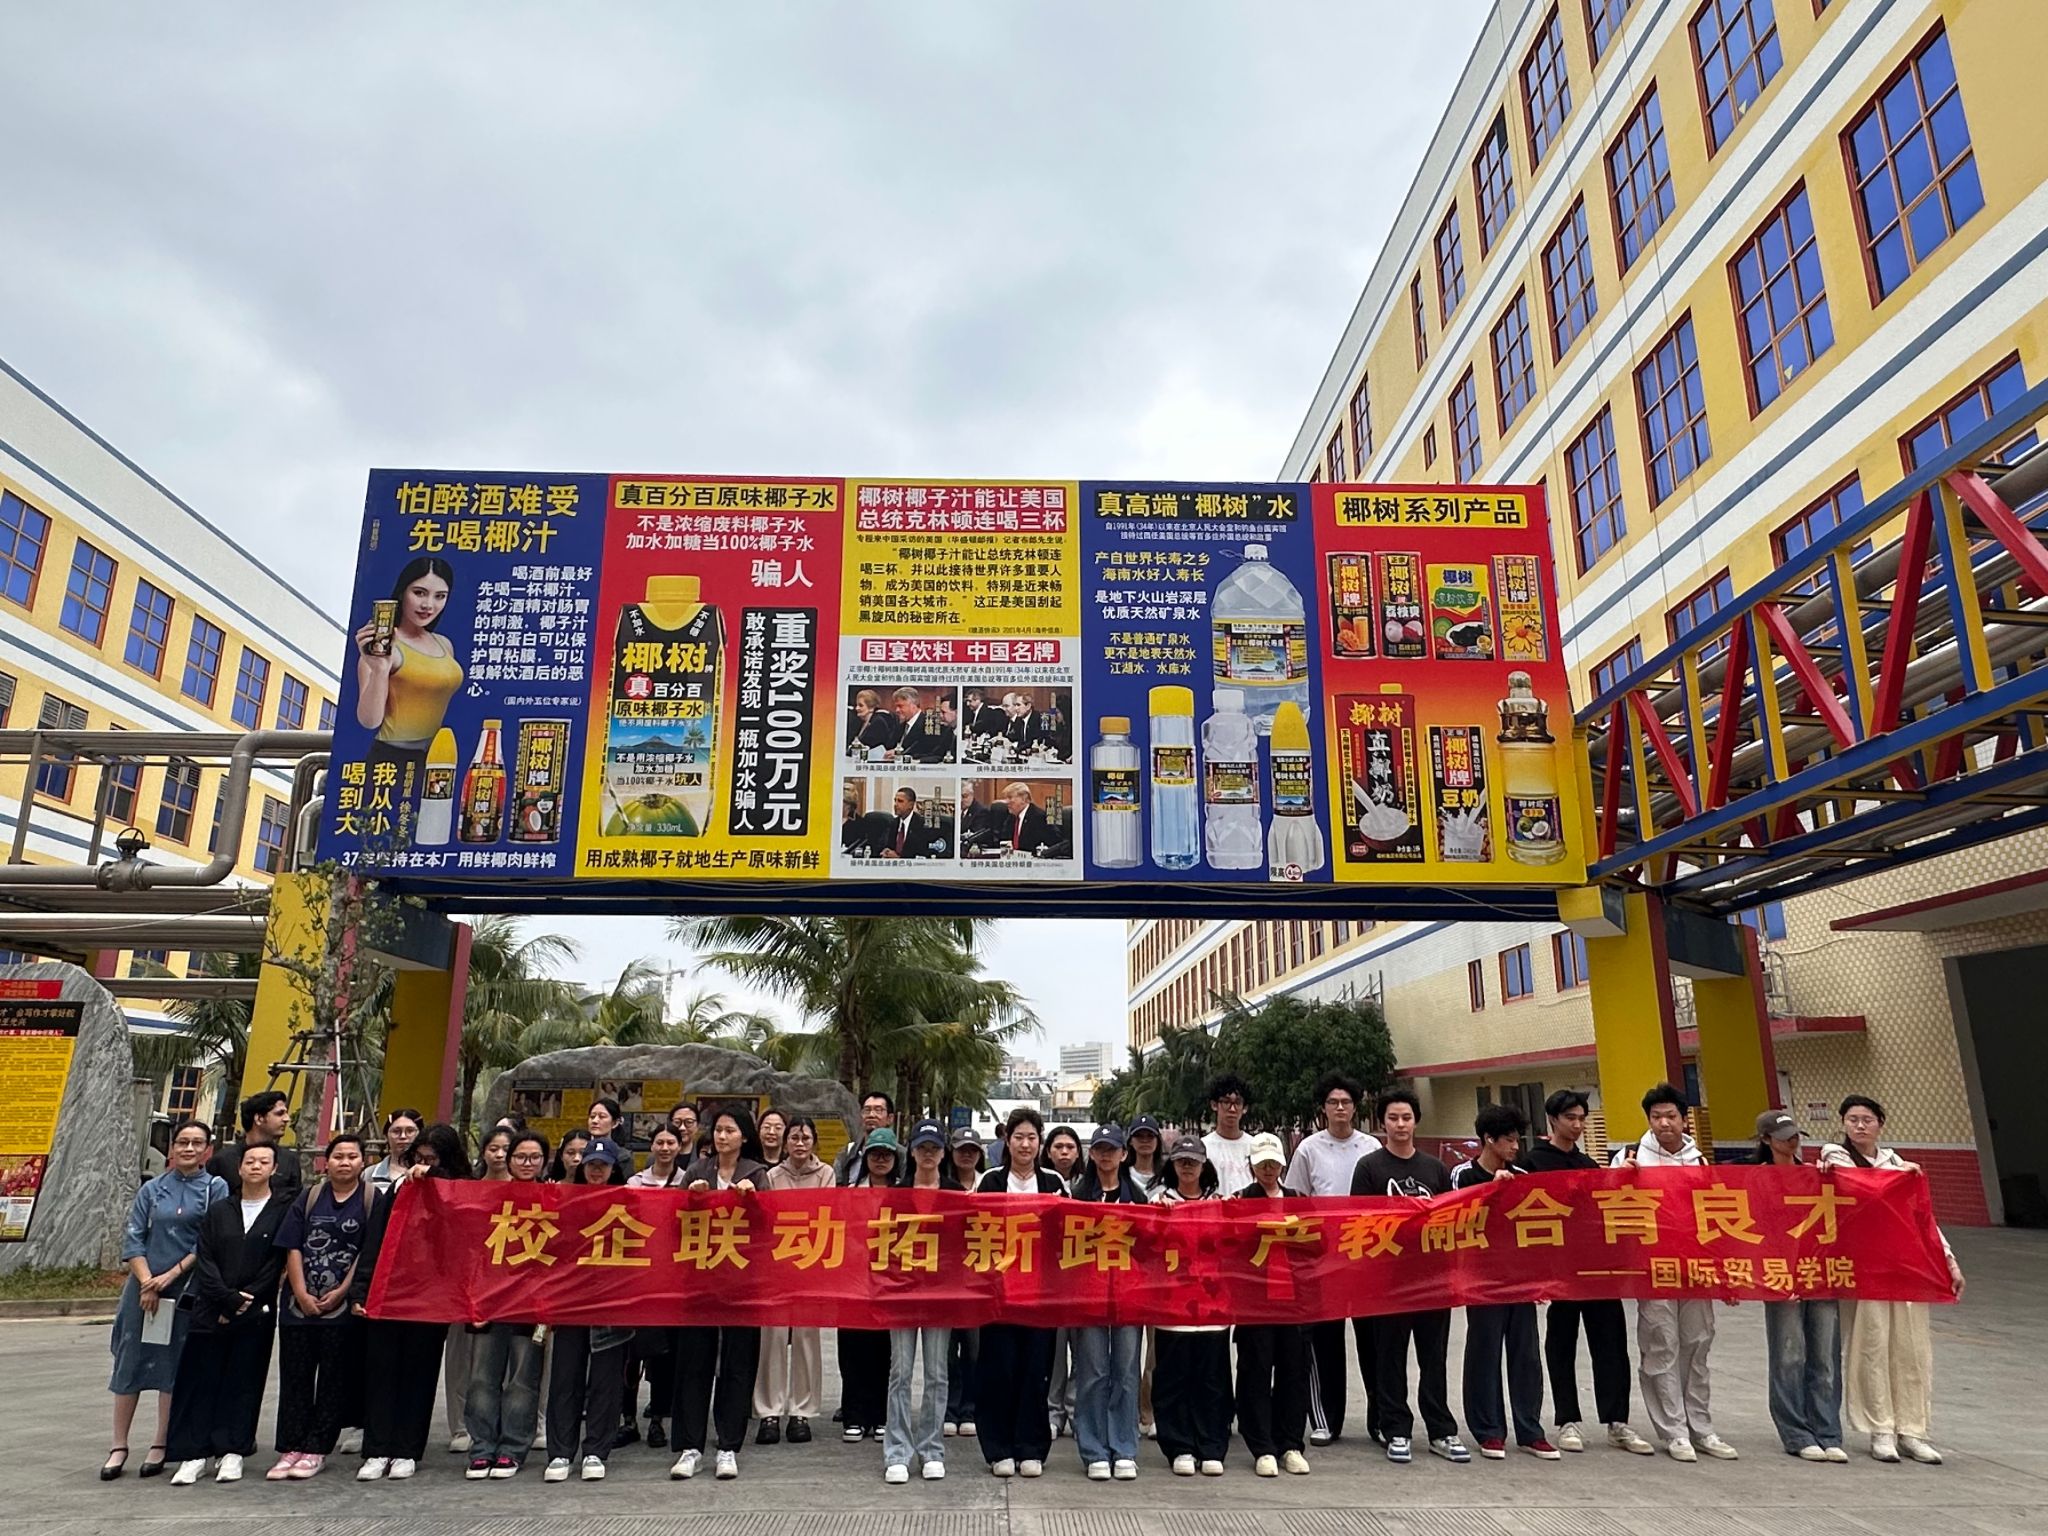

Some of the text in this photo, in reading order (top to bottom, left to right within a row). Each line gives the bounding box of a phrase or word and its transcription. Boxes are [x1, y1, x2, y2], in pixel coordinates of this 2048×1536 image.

[396, 481, 579, 516] 怕醉酒难受
[620, 484, 834, 508] 真百分百原味椰子水
[858, 487, 1064, 509] 椰树椰子汁能让美国
[858, 510, 1065, 531] 总统克林顿连喝三杯
[1343, 497, 1520, 525] 椰树系列产品
[637, 515, 805, 533] 不是浓缩废料椰子水
[408, 520, 557, 554] 先喝椰汁
[626, 533, 814, 551] 加水加糖当100%椰子水
[1094, 551, 1210, 565] 产自世界长寿之乡
[512, 566, 593, 581] 喝酒前最好
[751, 559, 814, 588] 骗人
[1102, 568, 1204, 582] 海南水好人寿长
[1443, 570, 1472, 583] 椰树
[1507, 565, 1527, 602] 椰树牌
[1341, 566, 1360, 606] 椰树牌
[476, 598, 590, 614] 减少酒精对肠胃
[1095, 591, 1207, 604] 是地下火山岩深层
[1102, 606, 1200, 620] 优质天然矿泉水
[473, 632, 587, 647] 中的蛋白可以保
[1109, 633, 1190, 645] 不是普通矿泉水
[621, 641, 708, 674] 椰树
[866, 641, 1055, 662] 国宴饮料 中国名牌
[1104, 648, 1196, 660] 更不是地表天然水
[469, 665, 583, 682] 缓解饮酒后的恶
[627, 677, 703, 698] 真 百分百
[615, 702, 703, 718] 原味椰子水
[1350, 700, 1404, 728] 椰树
[734, 612, 766, 830] 敢承诺发现一瓶加水骗人
[762, 612, 811, 831] 重奖100万元
[527, 737, 552, 786] 椰树牌
[616, 753, 695, 764] 不是用浓缩椰子水
[635, 764, 674, 774] 加水加糖
[1367, 730, 1394, 803] 真椰奶
[1446, 737, 1470, 785] 椰树牌
[675, 774, 702, 785] 坑人
[335, 762, 367, 836] 喝到大
[369, 761, 398, 836] 我从小
[1442, 789, 1479, 807] 豆奶
[585, 850, 820, 869] 用成熟椰子就地生产原味新鲜
[484, 1184, 1857, 1273] 校企联动拓新路，产教融合育良才
